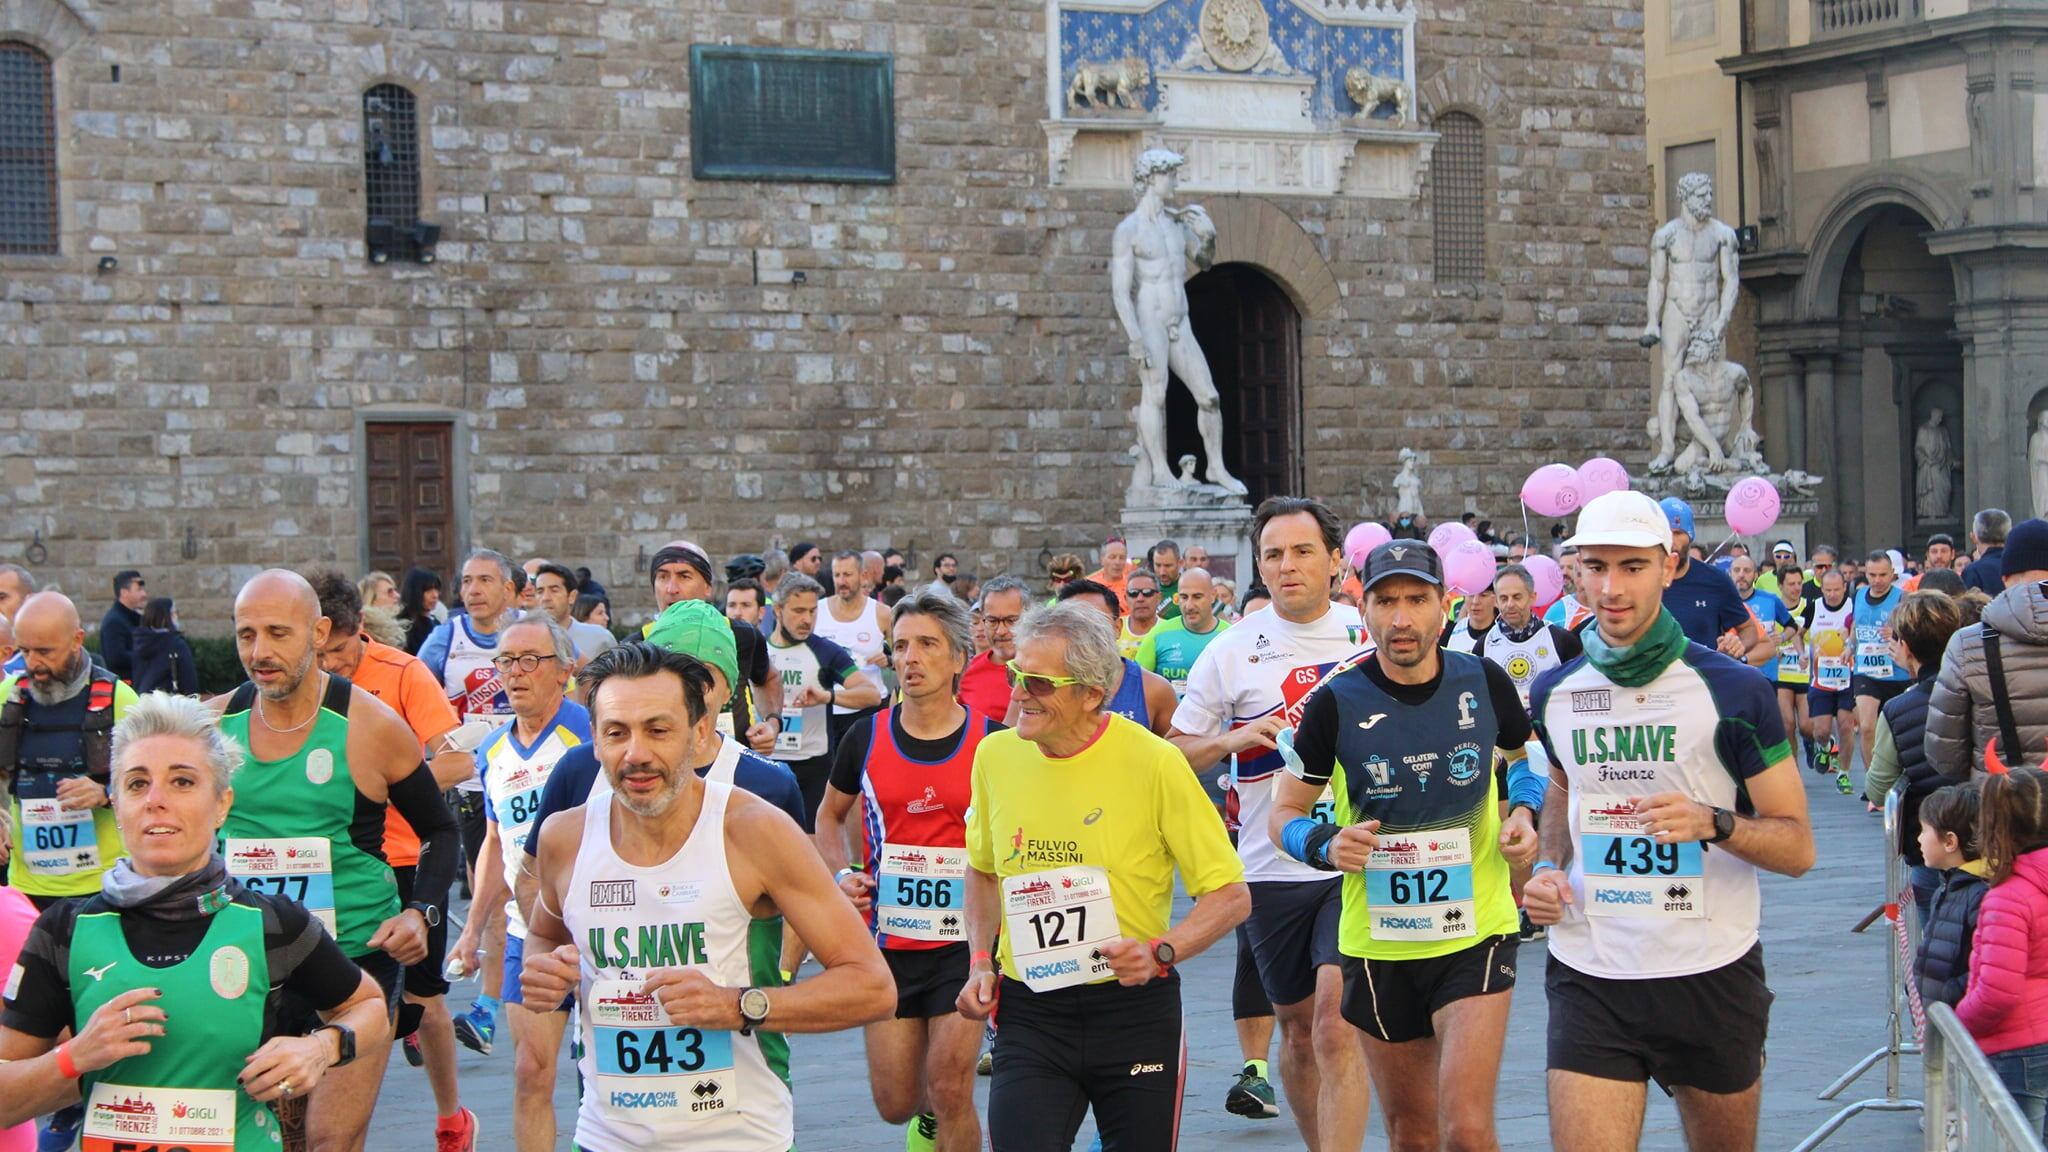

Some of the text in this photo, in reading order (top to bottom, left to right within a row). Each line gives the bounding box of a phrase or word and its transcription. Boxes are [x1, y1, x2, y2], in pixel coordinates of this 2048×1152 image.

[1864, 656, 1885, 666] 406
[475, 669, 491, 680] GS
[1296, 669, 1316, 684] GS
[1826, 668, 1843, 678] 712
[1403, 753, 1439, 764] GELATERIA
[1412, 762, 1433, 772] CONTI
[1598, 765, 1656, 781] Firenze
[1610, 820, 1638, 829] FIRENZE
[35, 824, 78, 850] 607
[1028, 840, 1077, 852] FULVIO
[1439, 841, 1458, 851] GIGLI
[297, 849, 318, 858] GIGLI
[1027, 851, 1083, 863] MASSINI
[1604, 837, 1679, 875] 439
[248, 863, 274, 871] FIRENZE
[943, 857, 960, 865] GIGLI
[902, 865, 924, 873] FIRENZE
[1072, 876, 1094, 887] GIGLI
[1390, 869, 1449, 904] 612
[896, 877, 951, 908] 566
[1595, 889, 1635, 904] HOKA
[1027, 896, 1052, 907] FIRENZE
[1664, 903, 1692, 911] errea
[886, 916, 918, 930] HOKA
[1028, 905, 1086, 949] 127
[1380, 917, 1417, 929] HOKA
[1442, 922, 1466, 933] errea
[1026, 962, 1063, 980] HOKA
[621, 1011, 653, 1021] FIRENZE
[616, 1028, 705, 1074] 643
[1141, 1064, 1164, 1073] asics
[611, 1091, 656, 1108] HOKA
[691, 1098, 724, 1112] errea
[187, 1107, 217, 1119] GIGLI
[115, 1120, 150, 1134] FIRENZE
